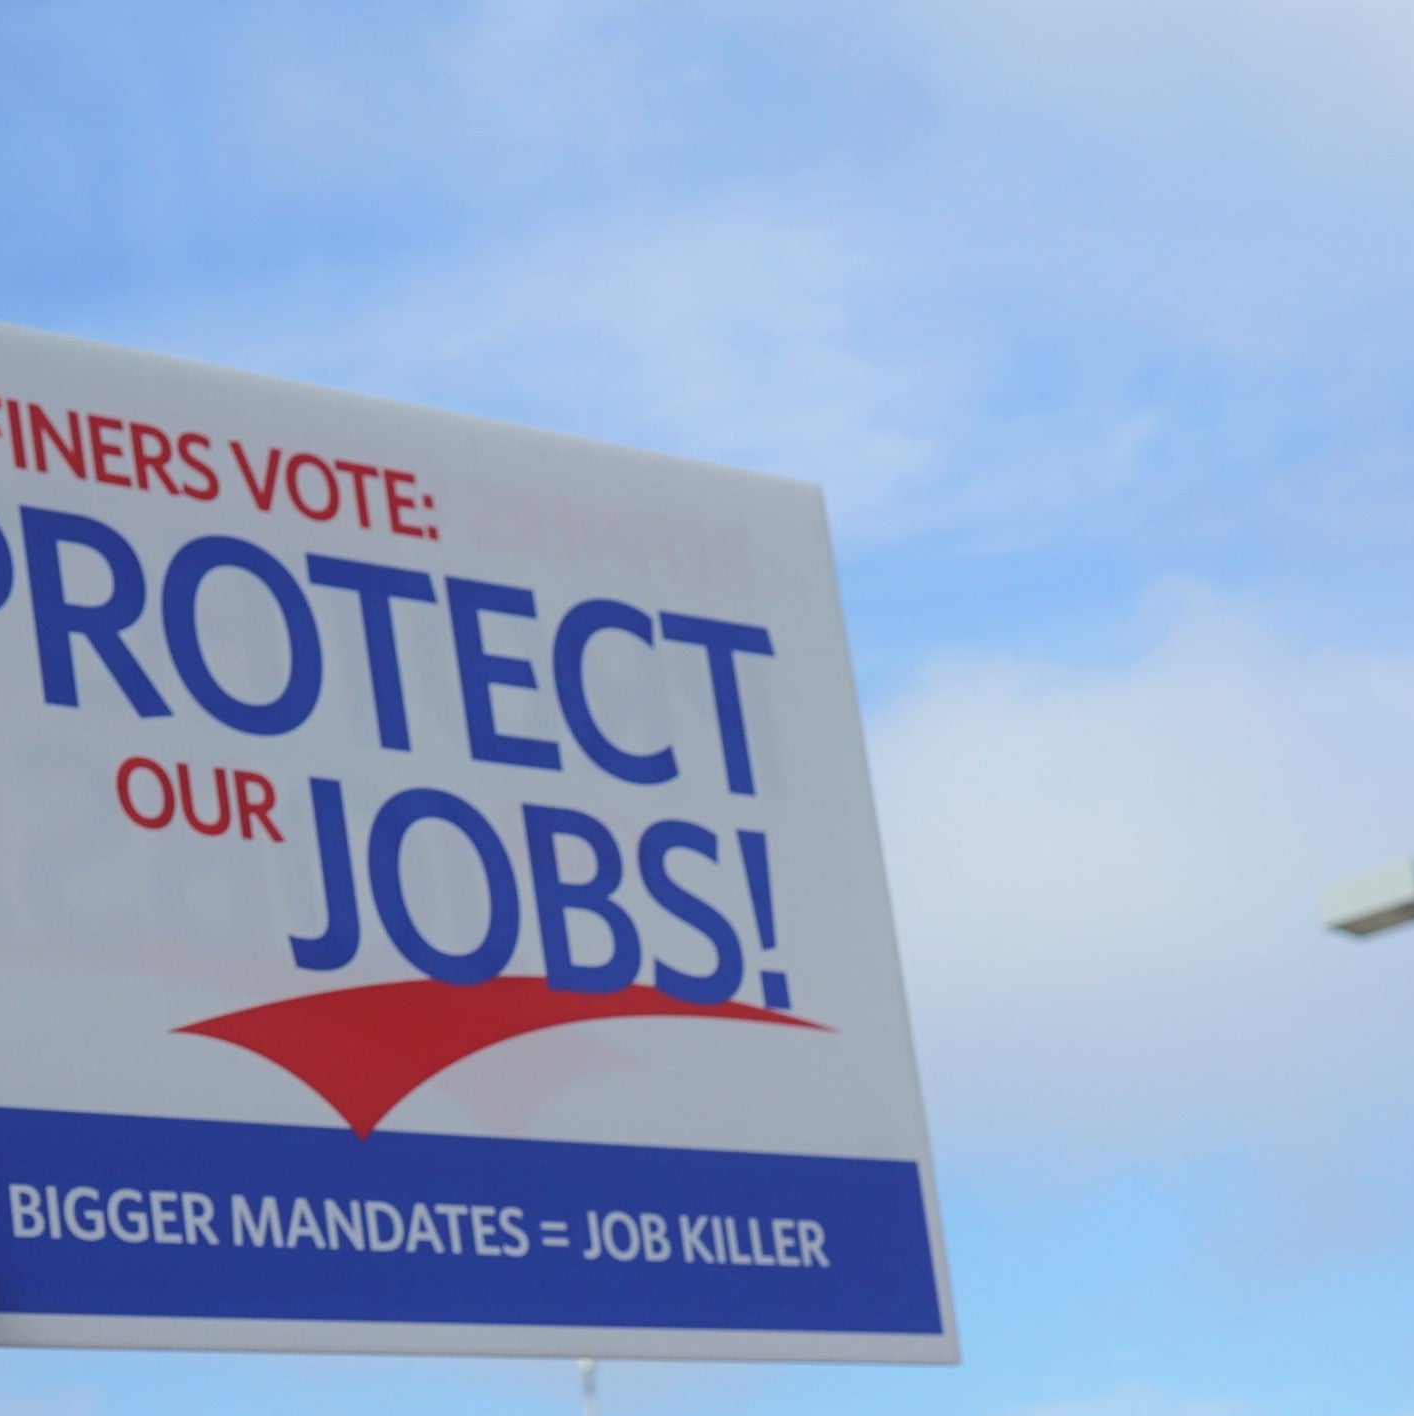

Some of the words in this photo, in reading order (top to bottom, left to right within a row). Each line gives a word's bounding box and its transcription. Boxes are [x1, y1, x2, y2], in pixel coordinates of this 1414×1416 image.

[229, 439, 439, 541] VOTE:
[116, 756, 284, 843] OUR
[288, 777, 793, 1013] JOBS!
[7, 1183, 219, 1247] BIGGER
[231, 1195, 531, 1258] MANDATES
[540, 1220, 571, 1249] =
[582, 1210, 673, 1262] JOB
[678, 1213, 831, 1268] KILLER
